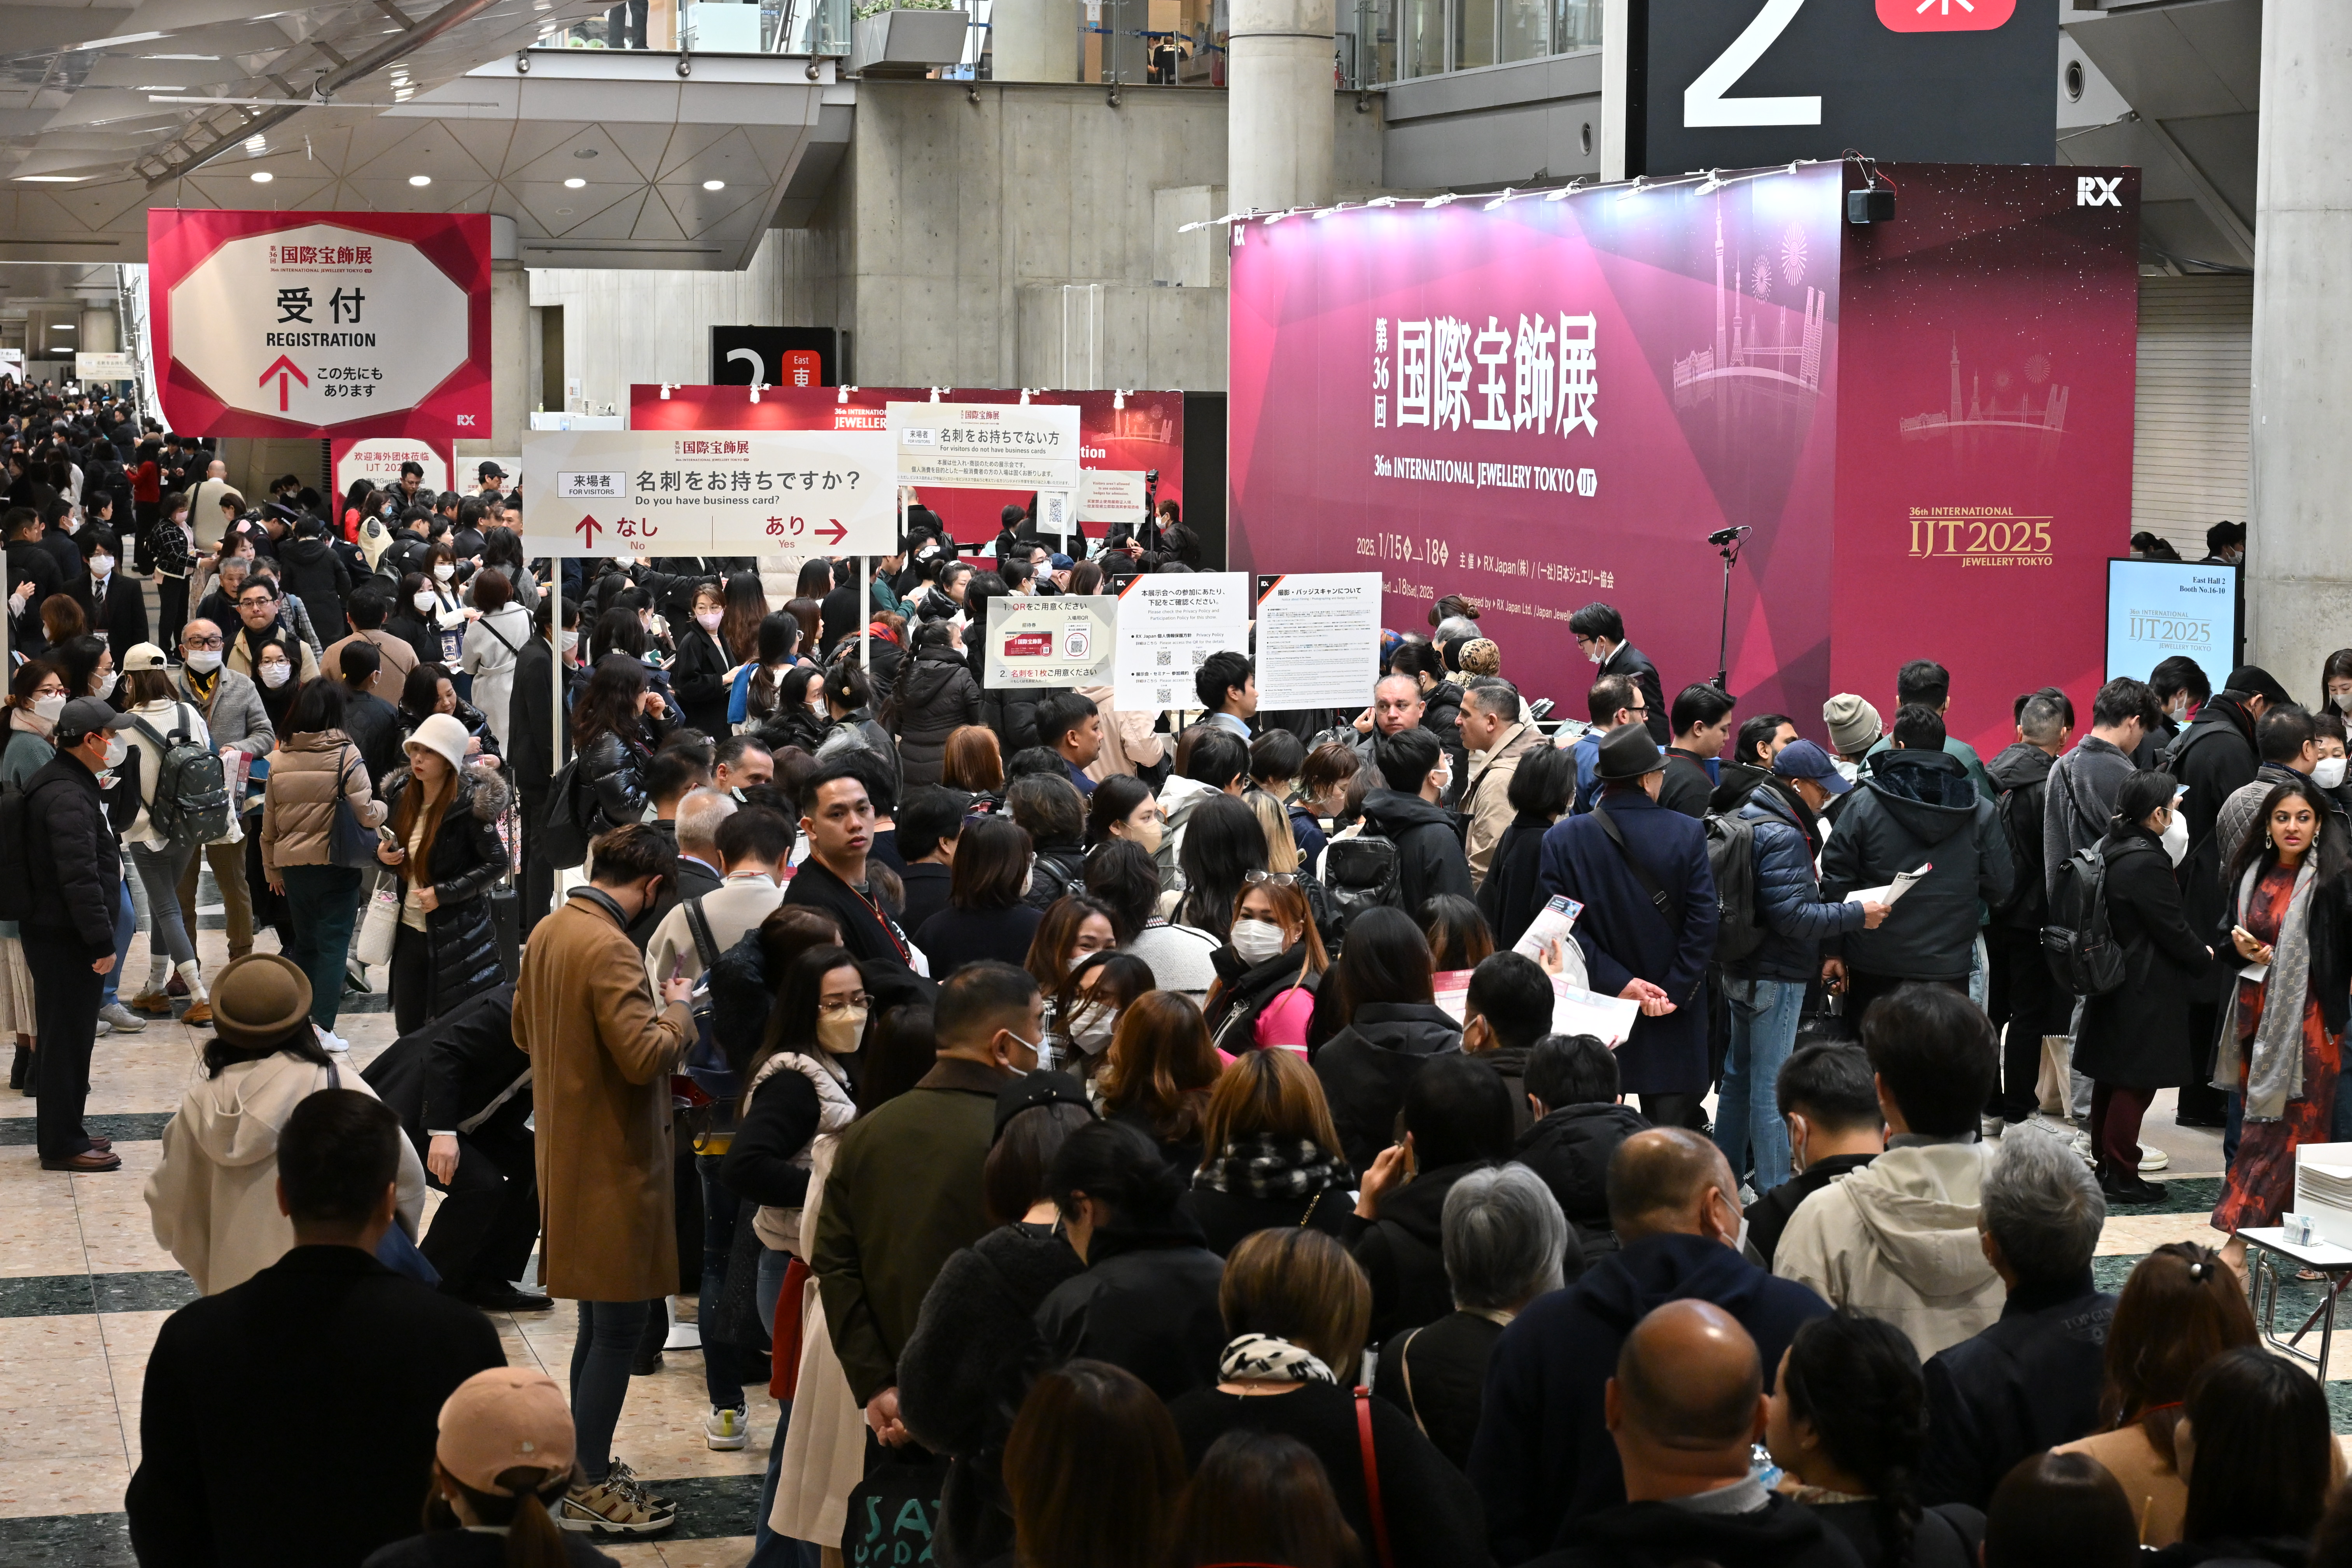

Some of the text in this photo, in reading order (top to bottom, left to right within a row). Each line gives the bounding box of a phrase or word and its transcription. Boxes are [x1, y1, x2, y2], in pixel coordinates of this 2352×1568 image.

[2076, 176, 2123, 207] RX
[282, 246, 372, 264] 国際宝飾展
[277, 287, 365, 324] 受付
[266, 332, 376, 346] REGISTRATION
[794, 356, 809, 364] East
[317, 367, 383, 380] この先にも
[793, 368, 809, 387] 東
[1396, 310, 1598, 439] 国際宝飾展
[324, 383, 376, 397] あります
[457, 415, 475, 425] RX
[965, 410, 999, 420] 国際宝飾展
[910, 430, 928, 438] 来場者
[940, 428, 1060, 445] 名刺をお持ちでない方
[683, 440, 749, 455] 国際宝飾展
[354, 452, 429, 461] 欢迎海外团体莅临
[574, 474, 611, 487] 来場者
[1374, 454, 1391, 477] 36th
[1394, 457, 1474, 485] INTERNATIONAL
[1477, 462, 1531, 489] JEWELLERY
[1534, 467, 1574, 493] TOKYO
[636, 470, 859, 492] 名刺をお持ちですか？
[635, 495, 780, 506] Do you have business card?
[1909, 506, 2013, 515] 36th INTERNATIONAL
[616, 517, 658, 537] なし
[765, 515, 805, 536] あり
[630, 541, 645, 550] No
[778, 539, 795, 548] Yes
[1357, 537, 1376, 556] 2025.
[1379, 532, 1402, 560] 1/15
[1426, 538, 1438, 565] 18
[1484, 555, 1494, 571] RX
[1962, 557, 2053, 568] JEWELLERY TOKYO
[1141, 588, 1225, 597] 本展示会への参加にあたり、
[1278, 587, 1362, 596] 撮影・バッジスキャンについて
[1420, 585, 1433, 599] 2025
[2198, 586, 2225, 594] No.16-10
[1485, 597, 1491, 611] by
[1497, 599, 1504, 611] RX
[1505, 600, 1521, 614] Japan
[1522, 603, 1532, 615] Ltd.
[1554, 608, 1574, 621] Jewelle
[1011, 668, 1097, 677] 名刺を1枚ご用意ください
